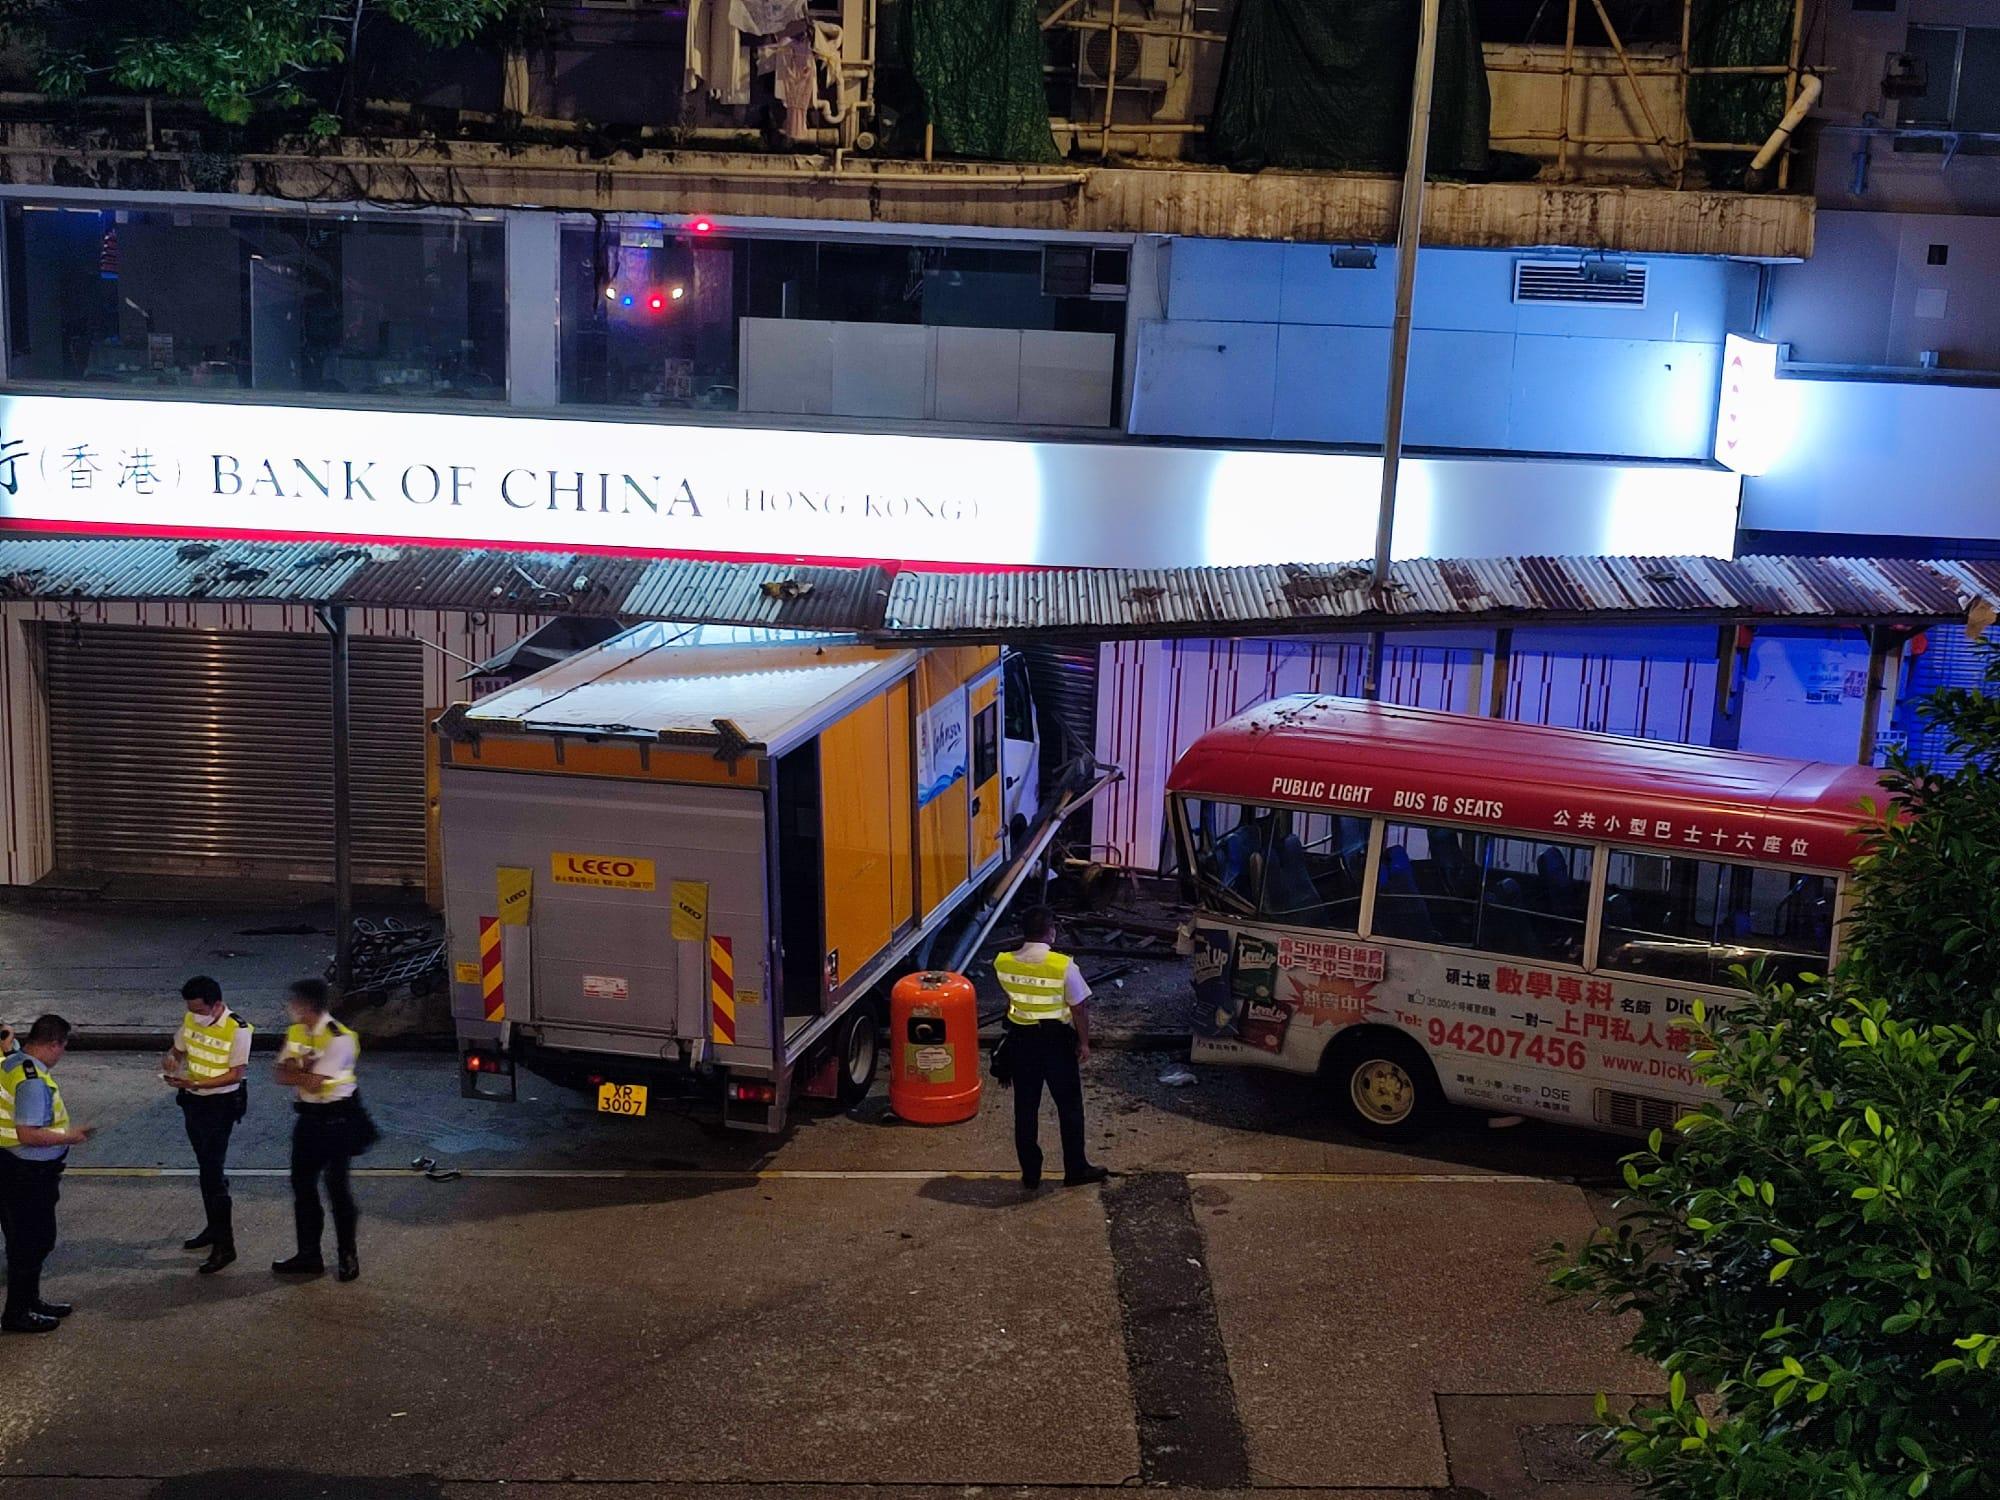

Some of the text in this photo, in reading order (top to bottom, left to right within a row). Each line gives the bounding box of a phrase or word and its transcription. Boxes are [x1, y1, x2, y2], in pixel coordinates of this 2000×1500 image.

[211, 454, 377, 501] BANK
[401, 463, 477, 506] OF
[501, 467, 703, 518] CHINA
[1271, 777, 1504, 819] PUBLIC LIGHT BUS 16 SEATS
[1553, 809, 1809, 857] 公共小型巴士十六座位
[567, 857, 635, 878] LEEO
[678, 901, 702, 921] LEEO
[1495, 966, 1615, 1011] 數學專科
[1621, 998, 1652, 1015] 名師
[1510, 1012, 1553, 1029] 一對一
[1428, 1016, 1587, 1071] 94207456
[612, 1085, 632, 1099] XR
[1541, 1086, 1570, 1101] DSE
[601, 1097, 642, 1116] 3007
